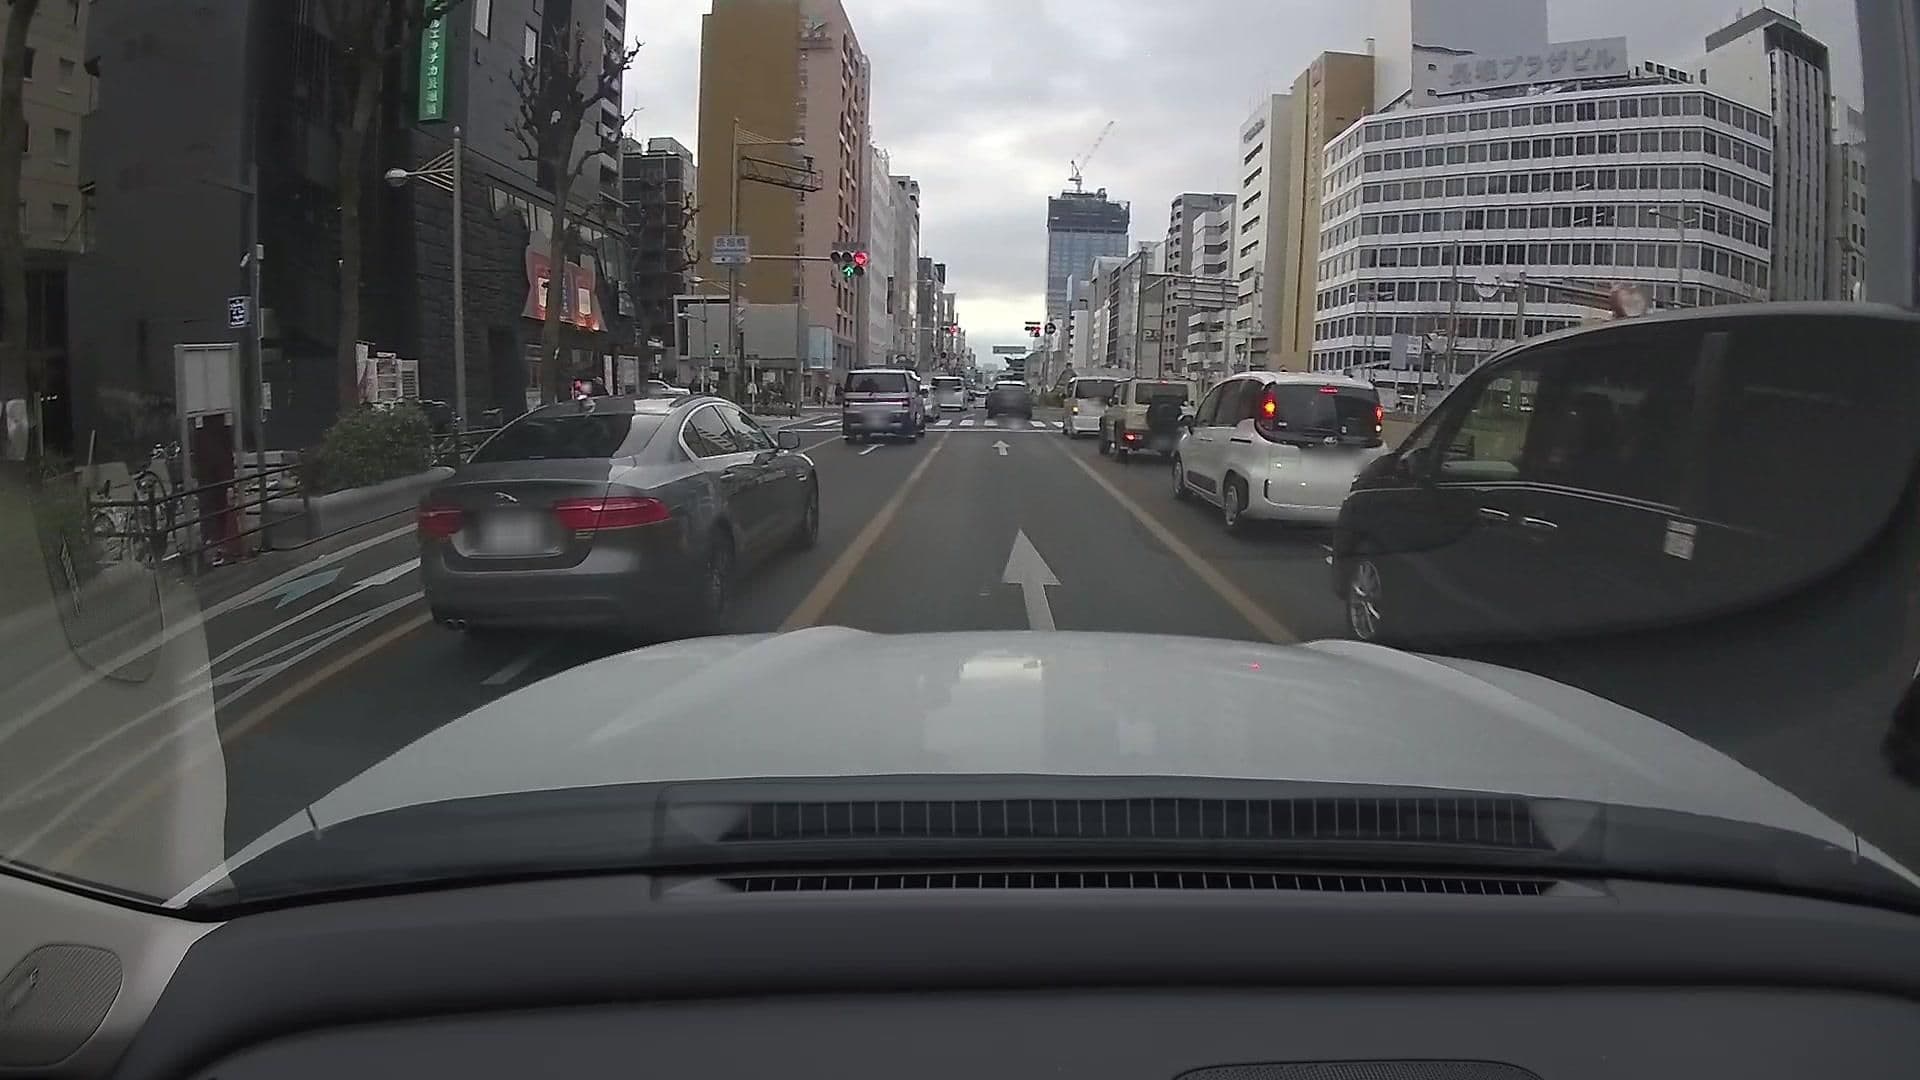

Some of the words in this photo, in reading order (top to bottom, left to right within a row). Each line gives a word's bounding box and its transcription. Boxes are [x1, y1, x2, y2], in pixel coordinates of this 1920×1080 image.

[1449, 47, 1617, 87] 長堀プラザビル
